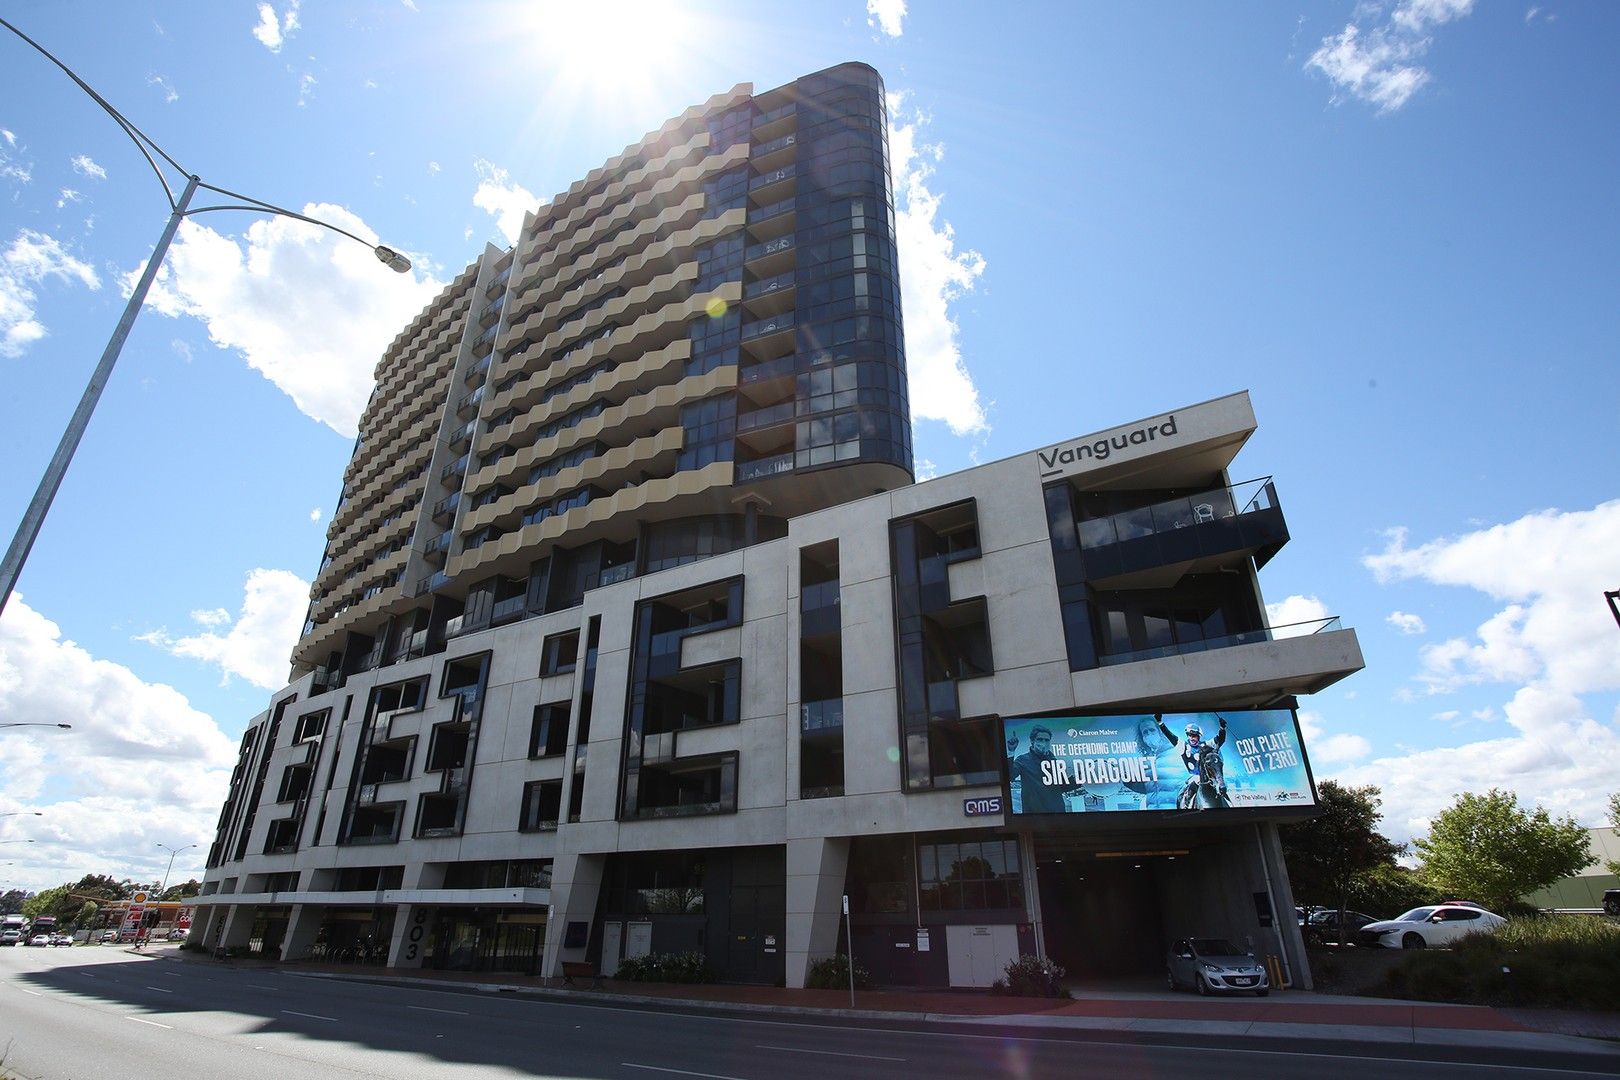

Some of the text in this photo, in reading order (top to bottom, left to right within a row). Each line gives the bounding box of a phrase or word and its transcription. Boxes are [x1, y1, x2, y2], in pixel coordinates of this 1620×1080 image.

[1039, 415, 1178, 468] Vanguard
[1099, 728, 1118, 736] Maher
[1235, 731, 1292, 756] COX PLATE
[1051, 741, 1138, 756] THE DEFENDING CHAMP
[1040, 756, 1158, 786] SIR DRAGONET
[1242, 749, 1298, 775] OCT 23RD
[405, 908, 427, 960] 803
